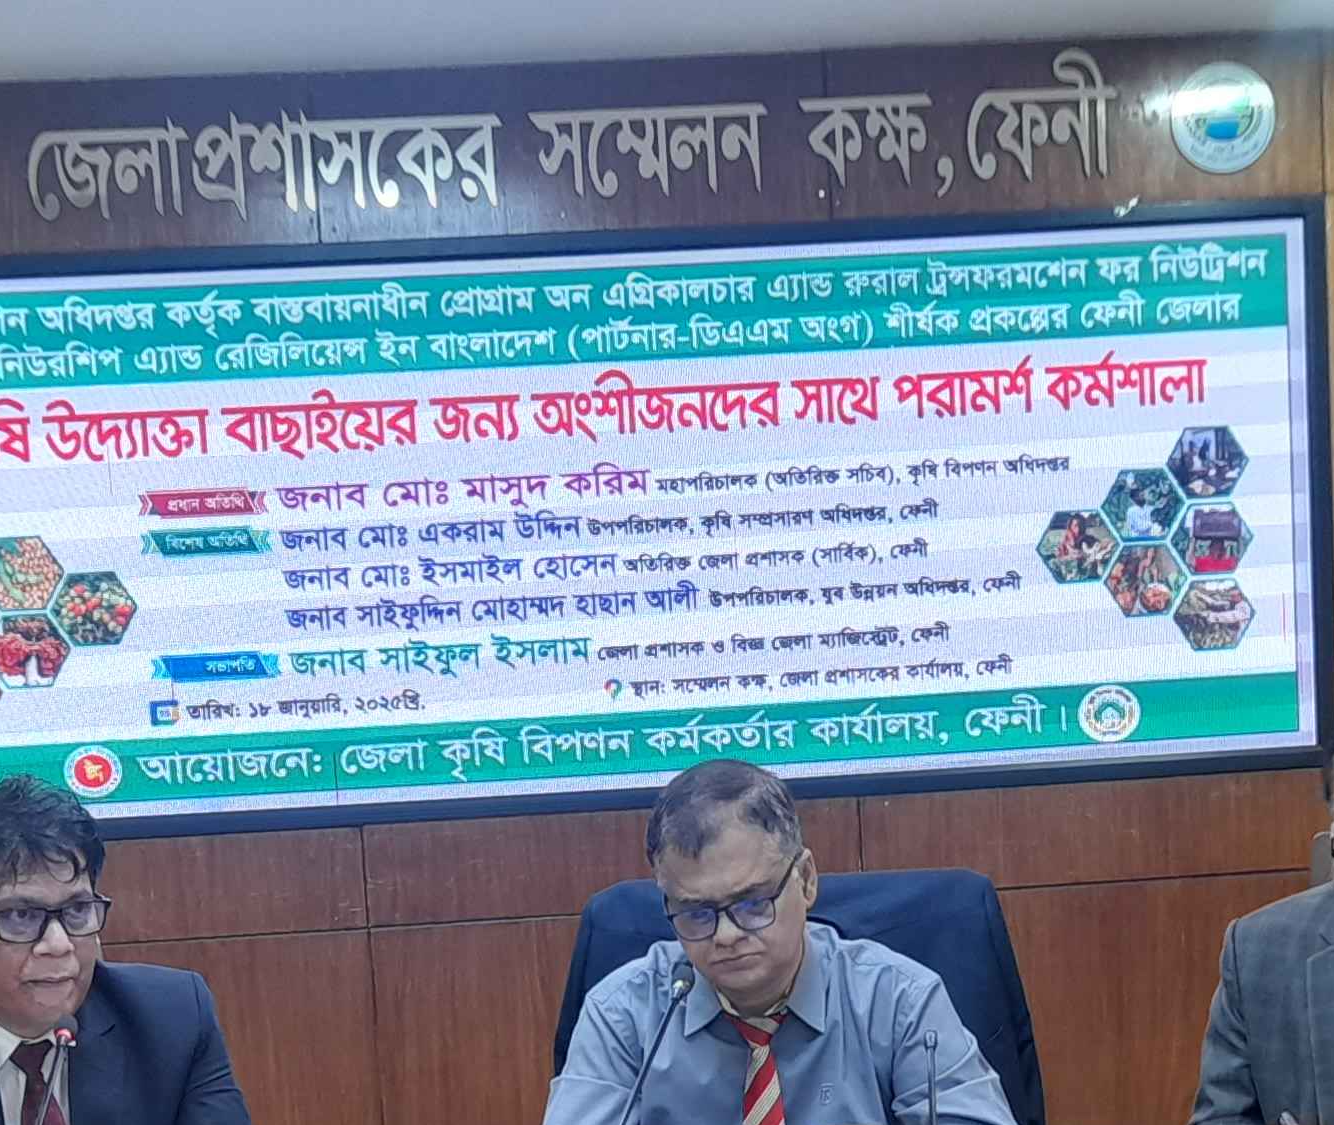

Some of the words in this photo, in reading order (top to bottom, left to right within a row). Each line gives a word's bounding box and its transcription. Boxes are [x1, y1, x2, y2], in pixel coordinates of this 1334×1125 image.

[528, 101, 768, 200] সম্মেলন
[35, 295, 157, 334] অধিদপ্তর
[162, 288, 244, 340] কর্তৃক
[249, 281, 431, 325] বাস্তবায়নাধীন
[439, 283, 537, 318] প্রোগ্রাম
[542, 283, 593, 312] অন
[602, 271, 758, 309] এগ্রিকালচার
[842, 266, 922, 297] রুরাল
[1095, 255, 1143, 286] ফর
[1148, 240, 1270, 283] নিউট্রিশন
[214, 331, 369, 372] রেজিলিয়েন্স
[374, 328, 421, 367] ইন
[426, 326, 558, 363] বাংলাদেশ
[883, 299, 960, 339] শীর্ষক
[967, 303, 1071, 334] প্রকল্পের
[1080, 288, 1147, 330] ফেনী
[1155, 291, 1244, 325] জেলার
[42, 398, 210, 464] উদ্যোক্তা
[221, 387, 419, 461] বাছাইয়ের
[428, 391, 519, 442] জন্য
[530, 368, 782, 443] অংশীজনদের
[790, 375, 881, 426] সাথে
[893, 354, 1033, 420] পরামর্শ
[1044, 350, 1208, 410] কর্মশালা
[276, 483, 368, 512] জনাব
[460, 473, 553, 508] মাসুদ
[559, 461, 651, 498] করিম
[654, 471, 759, 494] মহাপরিচালক
[906, 458, 940, 486] কৃষি
[943, 457, 998, 478] বিপণন
[1002, 453, 1070, 474] অধিদপ্তর
[280, 526, 349, 551] জনাব
[417, 518, 507, 545] একরাম
[513, 509, 583, 540] উদ্দিন
[699, 509, 732, 537] কৃষি
[899, 497, 939, 520] ফেনী
[282, 565, 352, 591] জনাব
[417, 552, 524, 586] ইসমাইল
[533, 553, 620, 581] হোসেন
[622, 552, 692, 574] অতিরিক্ত
[698, 552, 740, 571] জেলা
[745, 548, 806, 568] প্রশাসক
[890, 536, 929, 559] ফেনী
[283, 604, 348, 630] জনাব
[356, 594, 463, 631] সাইফুদ্দিন
[471, 594, 568, 622] মোহাম্মদ
[572, 590, 639, 617] হাছান
[643, 579, 701, 612] আলী
[982, 570, 1022, 592] ফেনী
[288, 647, 368, 677] জনাব
[376, 637, 483, 678] সাইফুল
[490, 632, 592, 669] ইসলাম
[597, 644, 640, 661] জেলা
[644, 640, 706, 659] প্রশাসক
[710, 640, 725, 653] ও
[771, 634, 814, 651] জেলা
[911, 621, 950, 643] ফেনী
[779, 670, 819, 688] জেলা
[824, 665, 900, 686] প্রশাসকের
[976, 653, 1013, 676] ফেনী
[248, 702, 272, 719] ১৮
[339, 740, 427, 775] জেলা
[440, 727, 509, 782] কৃষি
[518, 725, 632, 767] বিপণন
[644, 709, 797, 758] কর্মকর্তার
